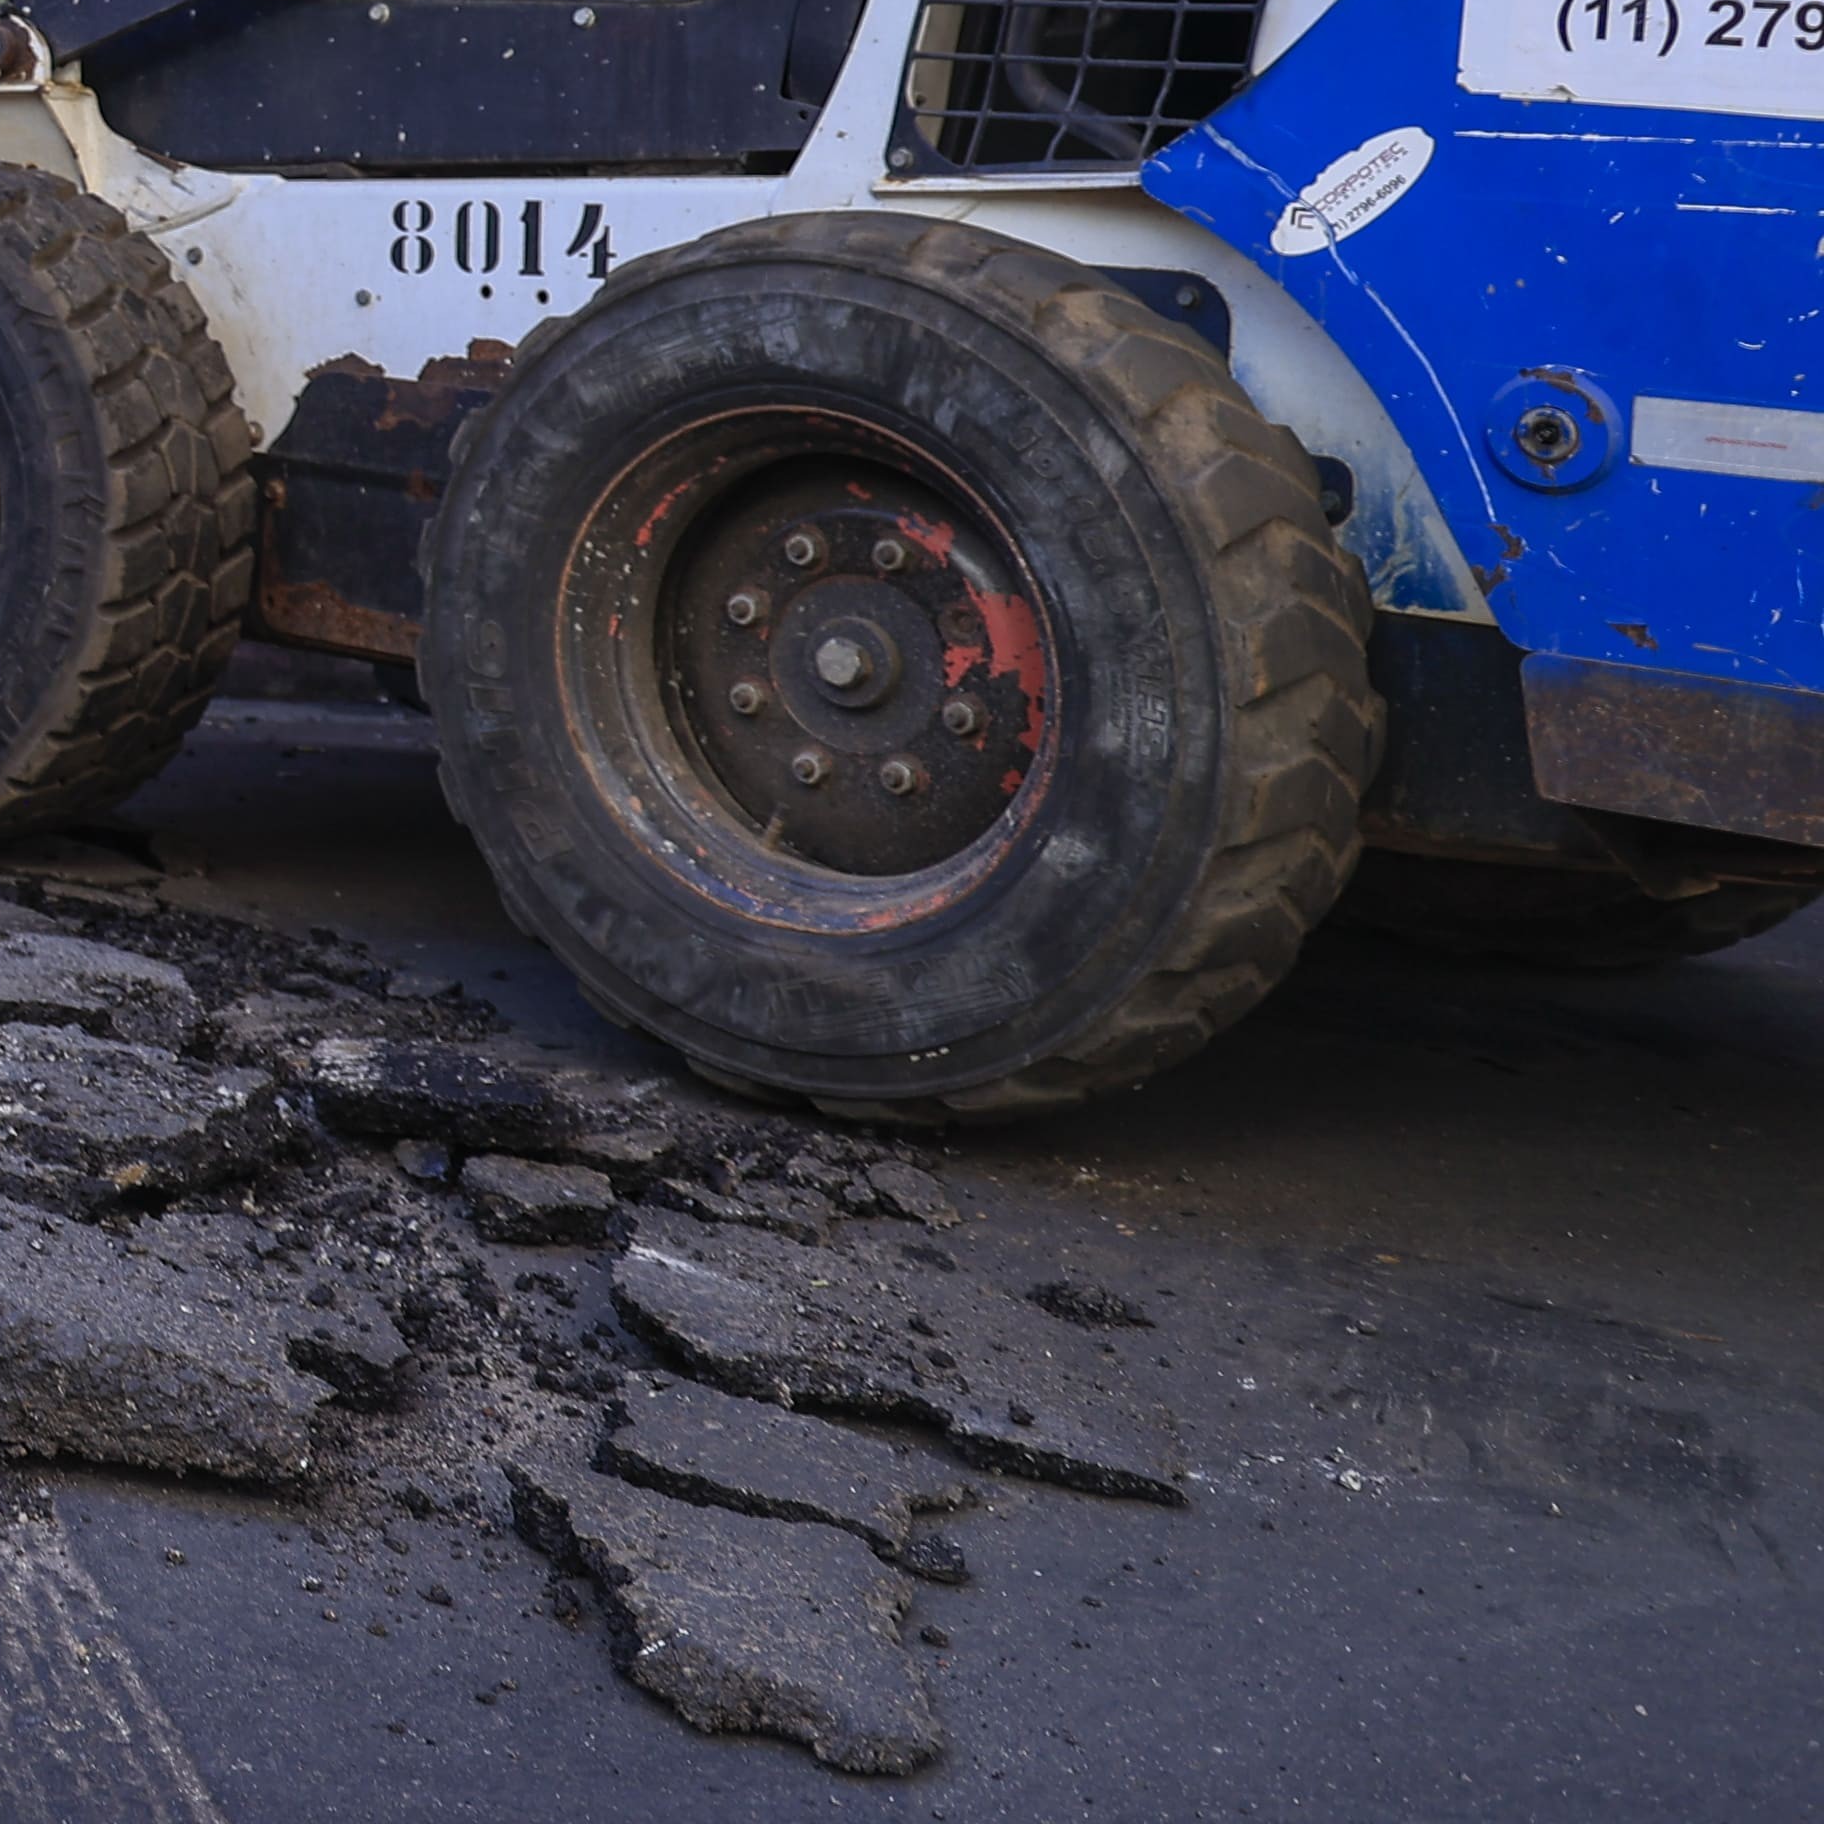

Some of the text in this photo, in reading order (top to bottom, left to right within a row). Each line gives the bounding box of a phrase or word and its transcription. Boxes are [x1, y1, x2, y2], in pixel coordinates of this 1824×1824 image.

[1313, 141, 1404, 212] CORPOTEC
[1345, 173, 1407, 224] 2796-6096
[390, 199, 617, 279] 8014
